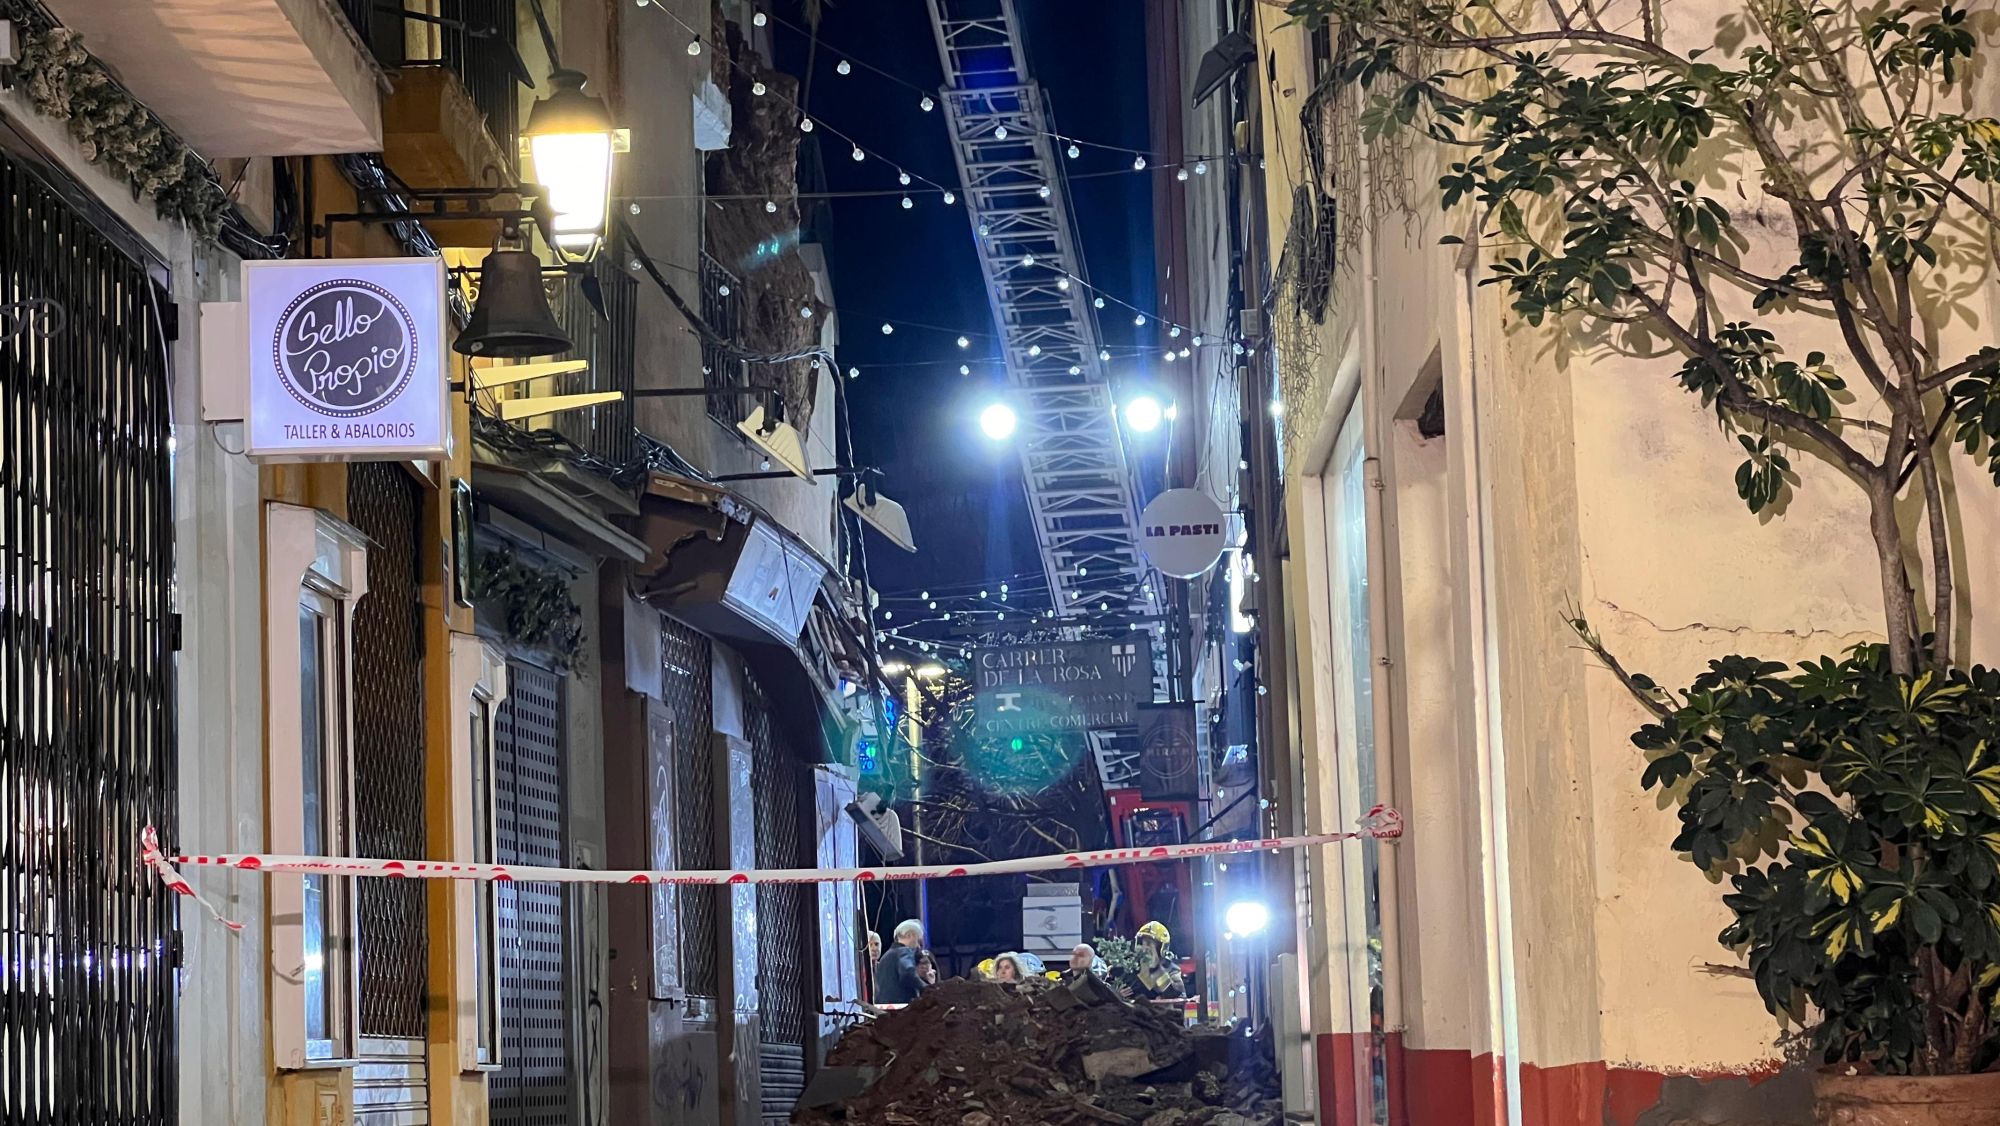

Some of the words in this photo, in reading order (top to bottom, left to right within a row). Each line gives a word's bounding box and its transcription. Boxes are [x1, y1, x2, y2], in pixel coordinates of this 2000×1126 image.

[288, 296, 381, 355] Sello
[303, 346, 403, 396] Propio
[284, 424, 327, 440] TALLER
[331, 424, 341, 440] &
[344, 423, 416, 439] ABALORIOS
[1146, 525, 1165, 537] LA
[1169, 524, 1219, 537] PASTI
[982, 648, 1066, 667] CARRER
[985, 669, 1010, 687] DE
[1019, 668, 1043, 685] LA
[1054, 664, 1102, 682] ROSA
[1050, 711, 1133, 729] COMERCIAL
